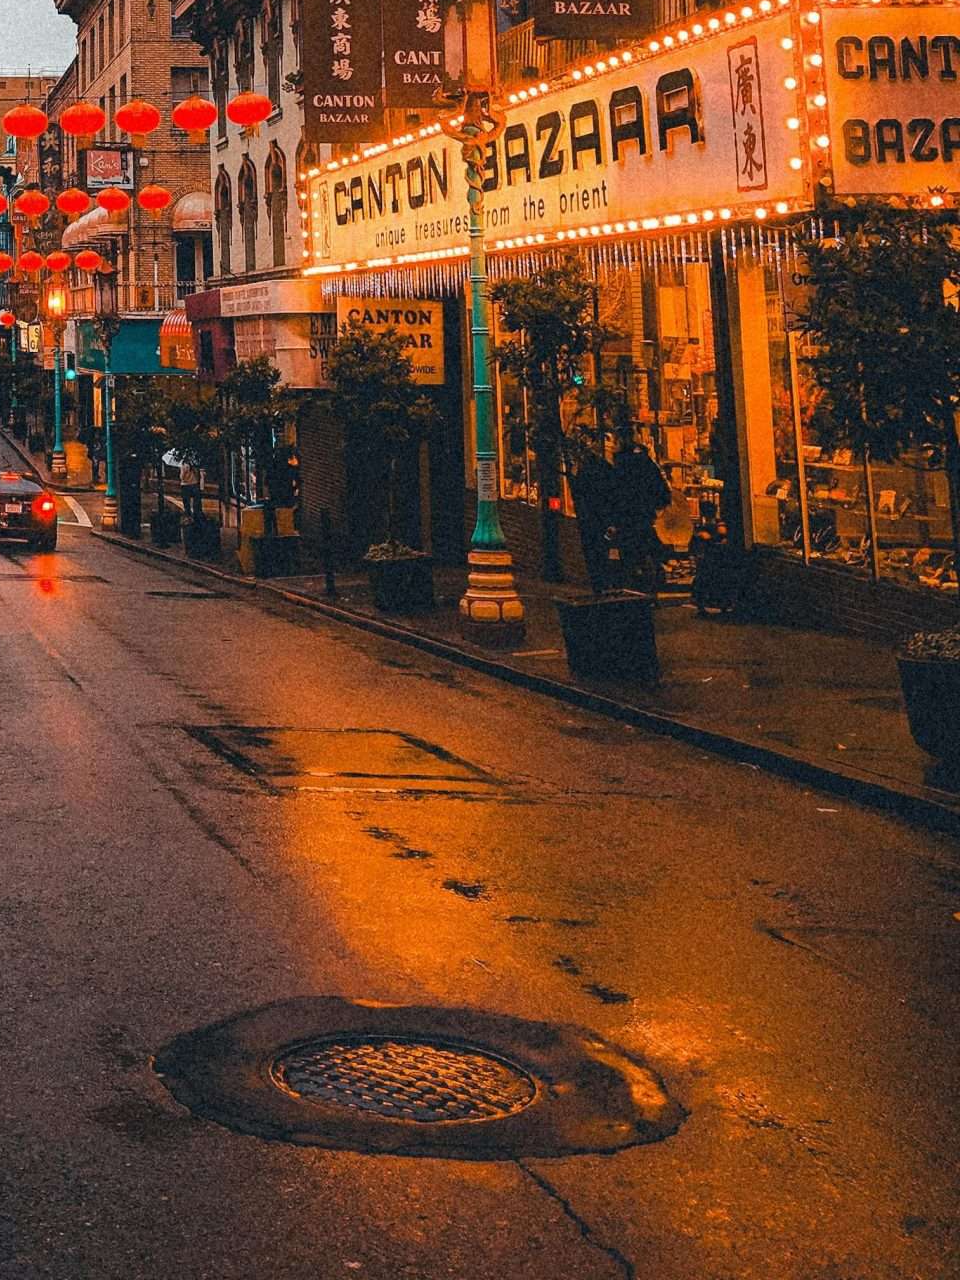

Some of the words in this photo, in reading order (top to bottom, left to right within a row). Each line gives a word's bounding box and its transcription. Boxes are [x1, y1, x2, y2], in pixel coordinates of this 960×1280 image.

[554, 1, 632, 16] BAZAAR
[394, 50, 442, 65] CANT
[403, 73, 441, 84] BAZA
[313, 94, 375, 108] CANTON
[319, 113, 369, 123] BAZAAR
[733, 53, 764, 182] 廣東
[334, 148, 449, 226] CANTON
[482, 67, 705, 193] BAZAAR
[90, 153, 120, 174] Kan's
[375, 226, 406, 249] unique
[415, 213, 469, 239] treasures
[523, 195, 546, 221] the
[559, 179, 609, 214] orient
[348, 308, 433, 326] CANTON
